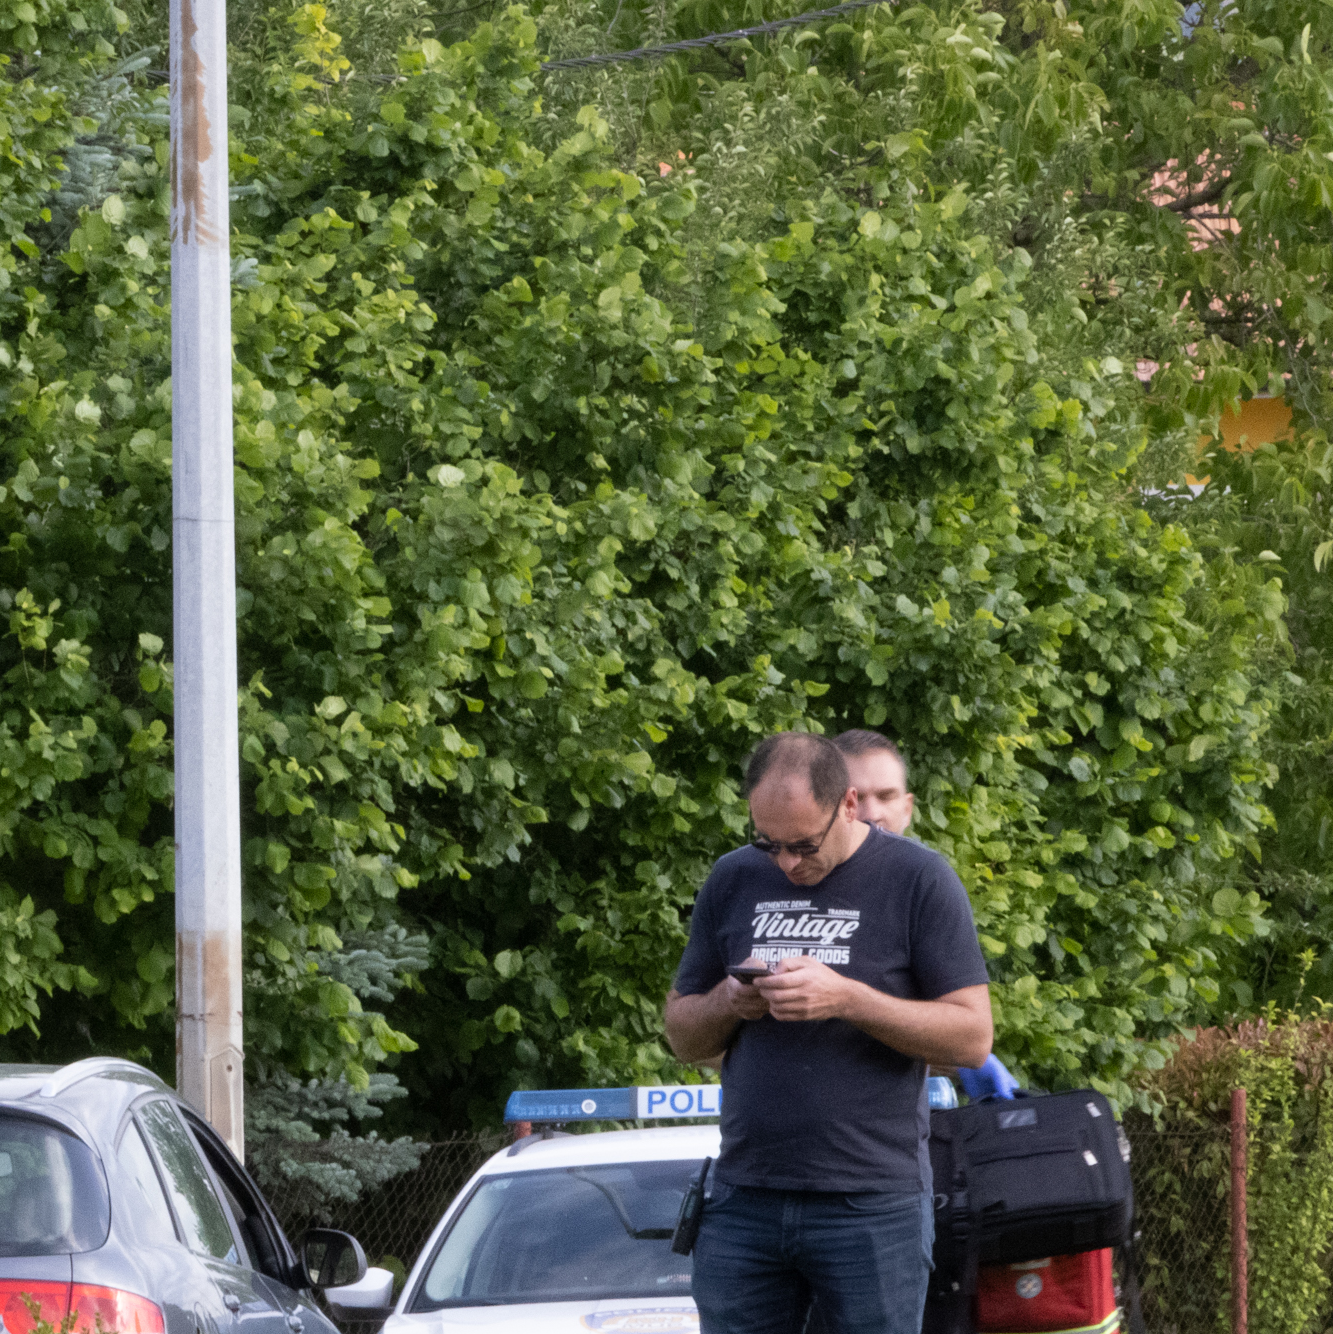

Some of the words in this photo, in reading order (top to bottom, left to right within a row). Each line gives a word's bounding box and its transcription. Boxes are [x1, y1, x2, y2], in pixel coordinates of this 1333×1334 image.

[755, 901, 790, 910] AUTHENTIC
[827, 908, 861, 917] TRADEMARK
[751, 911, 860, 945] Vintage
[808, 948, 850, 965] GOODS
